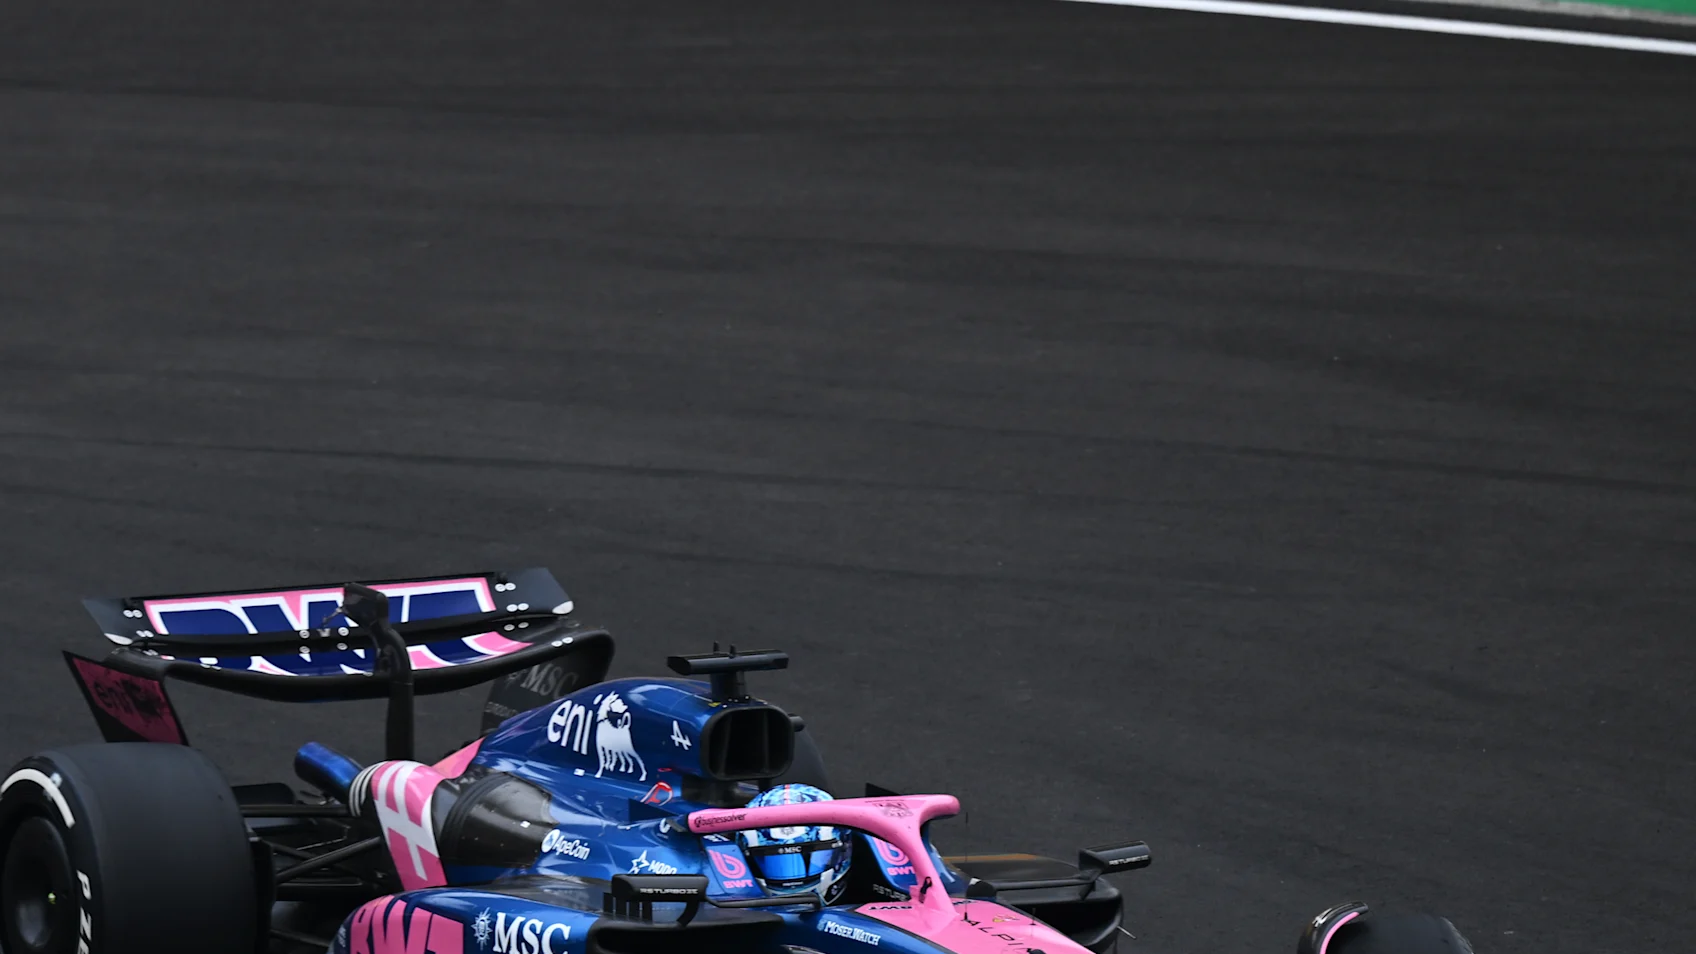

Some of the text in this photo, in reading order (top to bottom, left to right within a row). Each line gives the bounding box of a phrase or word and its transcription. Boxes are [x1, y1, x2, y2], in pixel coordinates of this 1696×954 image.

[547, 699, 593, 755] eni
[555, 839, 591, 861] ApeCoin
[76, 869, 92, 900] P
[722, 879, 754, 889] BWT
